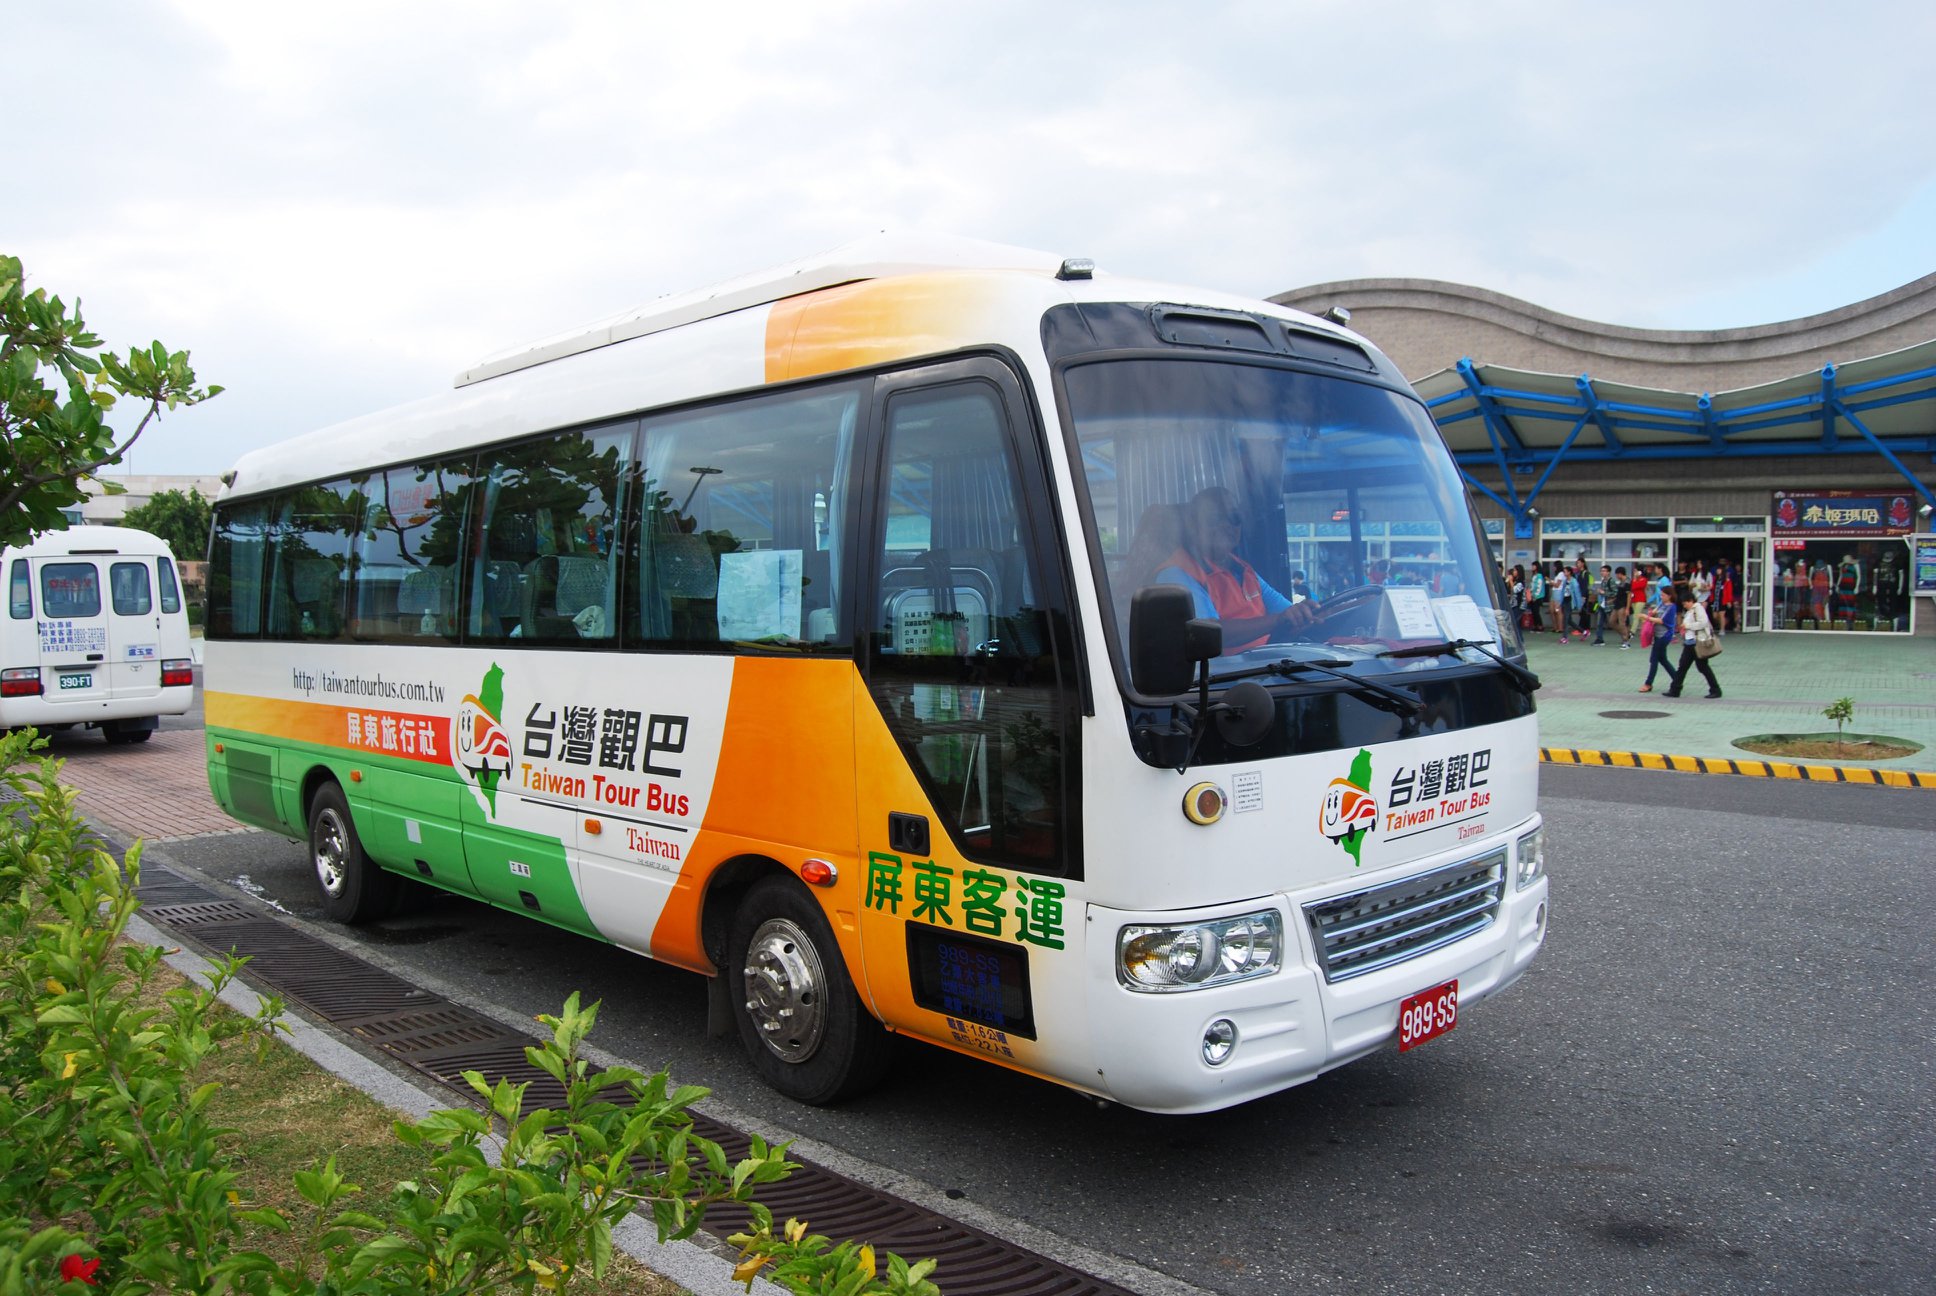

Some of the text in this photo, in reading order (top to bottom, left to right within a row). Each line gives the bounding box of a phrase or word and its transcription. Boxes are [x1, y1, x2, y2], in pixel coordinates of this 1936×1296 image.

[61, 675, 91, 688] 390-FT
[347, 712, 437, 756] 屏東旅行社
[523, 703, 690, 778] 台灣觀巴
[521, 763, 689, 817] Taiwan Tour Bus
[1389, 749, 1491, 808] 台灣觀巴
[1386, 791, 1490, 832] Taiwan Tour Bus
[1458, 823, 1485, 841] Taiwan
[626, 828, 680, 860] Taiwan
[865, 851, 1066, 950] 屏東客運
[938, 943, 1000, 974] 989-SS
[1402, 991, 1457, 1044] 989-SS
